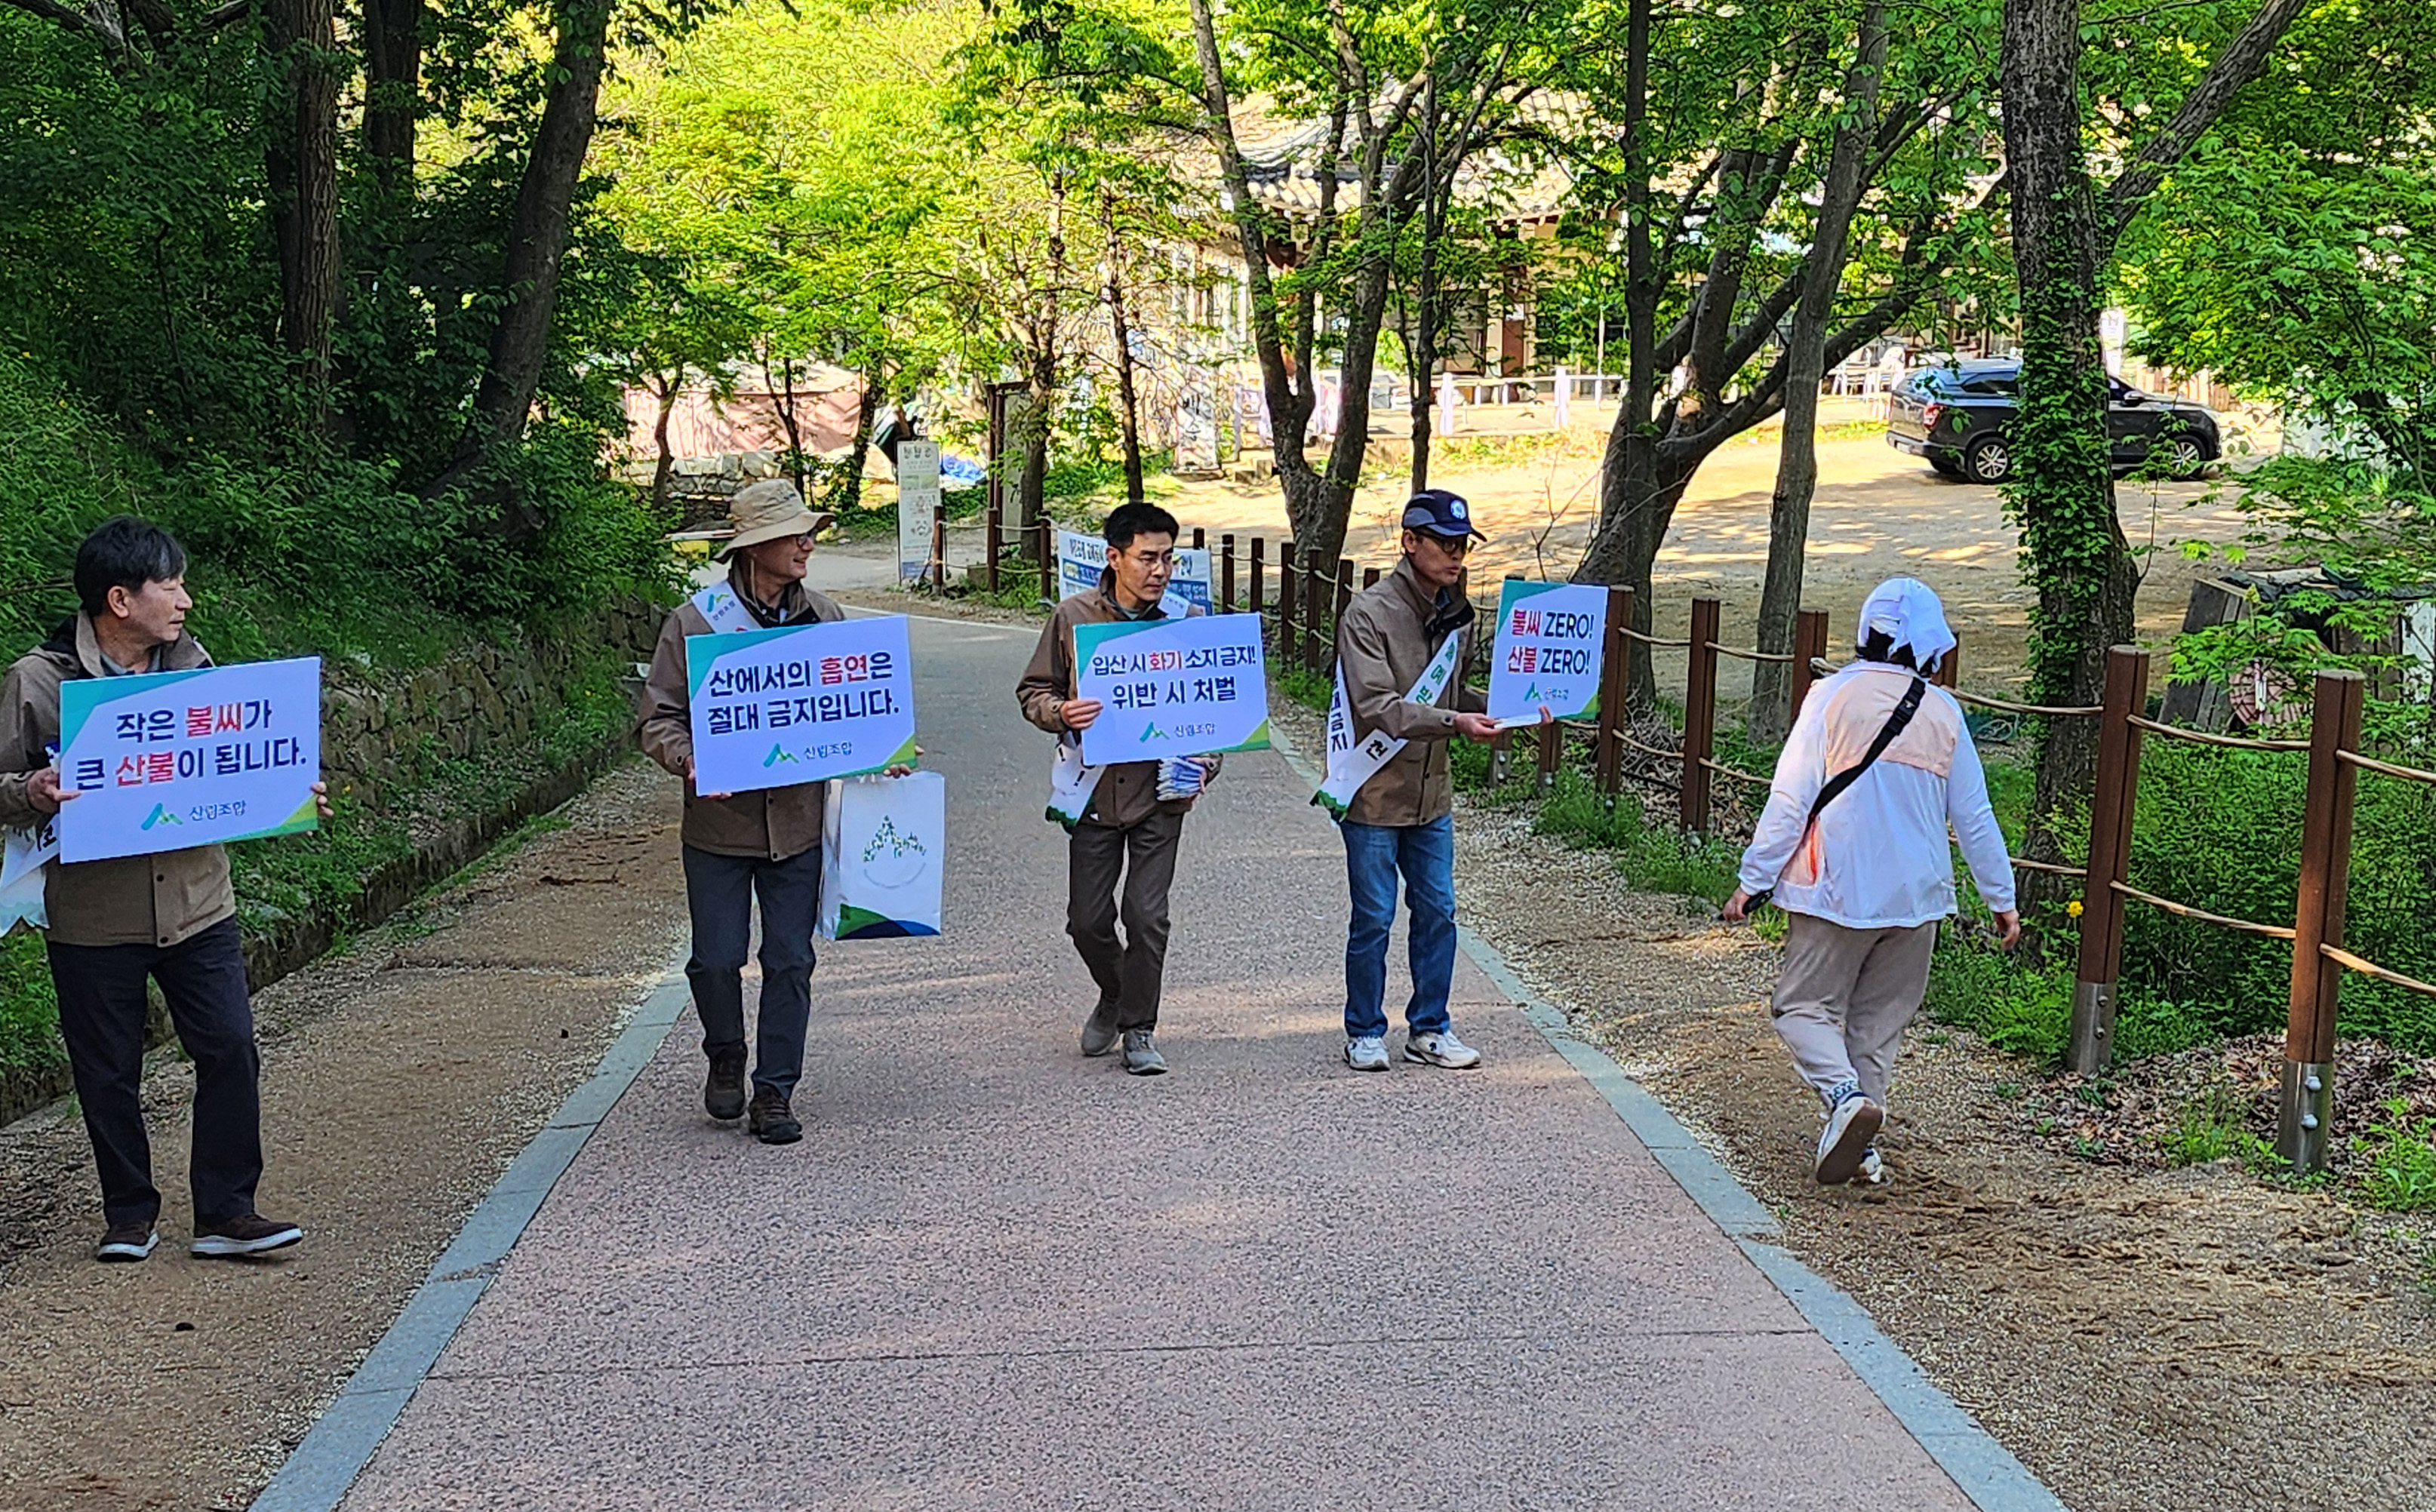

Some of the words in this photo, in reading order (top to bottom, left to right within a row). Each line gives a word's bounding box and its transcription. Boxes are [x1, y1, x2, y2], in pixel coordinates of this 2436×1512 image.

[1511, 609, 1541, 638] 불씨
[1543, 613, 1595, 640] ZERO!
[708, 659, 811, 698] 산에서의
[819, 650, 894, 687] 흡연은
[1092, 653, 1127, 676] 입산
[1130, 652, 1146, 673] 시
[1149, 651, 1182, 671] 화기
[1185, 648, 1217, 669] 소지
[1220, 645, 1256, 666] 금지!
[1508, 646, 1537, 673] 산불
[1539, 648, 1590, 675] ZERO!
[707, 702, 759, 736] 절대
[767, 687, 900, 730] 금지입니다.
[1112, 682, 1158, 709] 위반
[1165, 680, 1186, 705] 시
[1193, 676, 1236, 702] 처벌
[116, 708, 176, 743] 작은
[186, 699, 272, 737] 불씨가
[75, 758, 105, 791] 큰
[115, 748, 205, 788] 산불이
[214, 736, 307, 777] 됩니다.
